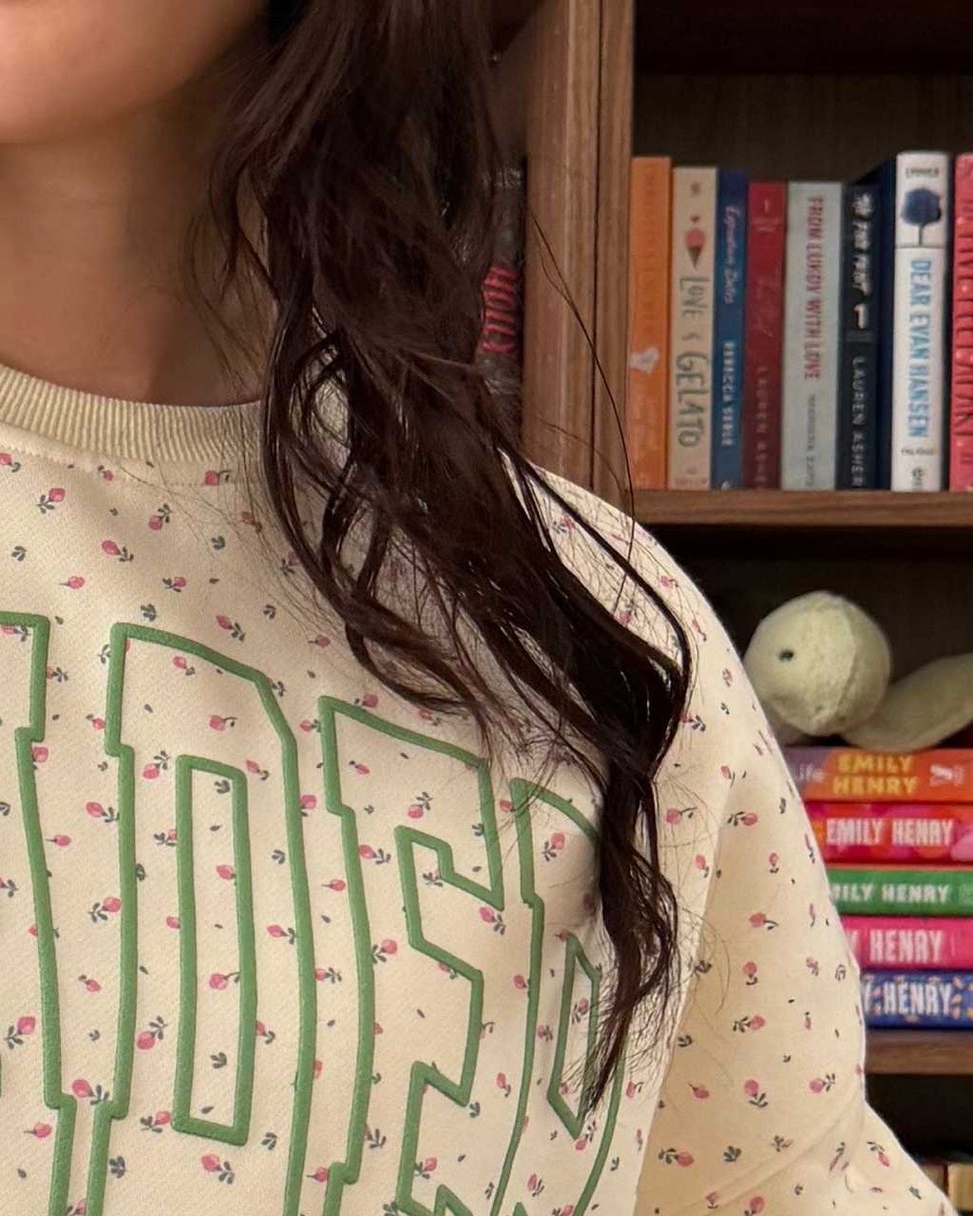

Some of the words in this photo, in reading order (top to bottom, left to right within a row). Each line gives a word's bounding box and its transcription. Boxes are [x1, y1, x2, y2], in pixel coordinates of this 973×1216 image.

[807, 197, 824, 239] FROM
[911, 260, 931, 306] DEAR
[805, 299, 823, 338] WITH
[910, 313, 931, 360] EVAN
[804, 341, 822, 380] LOVE
[676, 351, 710, 447] GELATO
[852, 356, 866, 425] LAUREN
[909, 364, 930, 438] HANSEN
[755, 442, 767, 485] ASHE
[851, 431, 865, 486] ASHER
[837, 754, 913, 773] EMILY
[832, 776, 918, 795] HENRY
[826, 818, 883, 845] EMILY
[891, 818, 953, 846] HENRY
[831, 883, 874, 902] MILY
[881, 884, 949, 903] HENRY
[870, 930, 943, 962] HENRY
[883, 982, 952, 1015] HENRY
